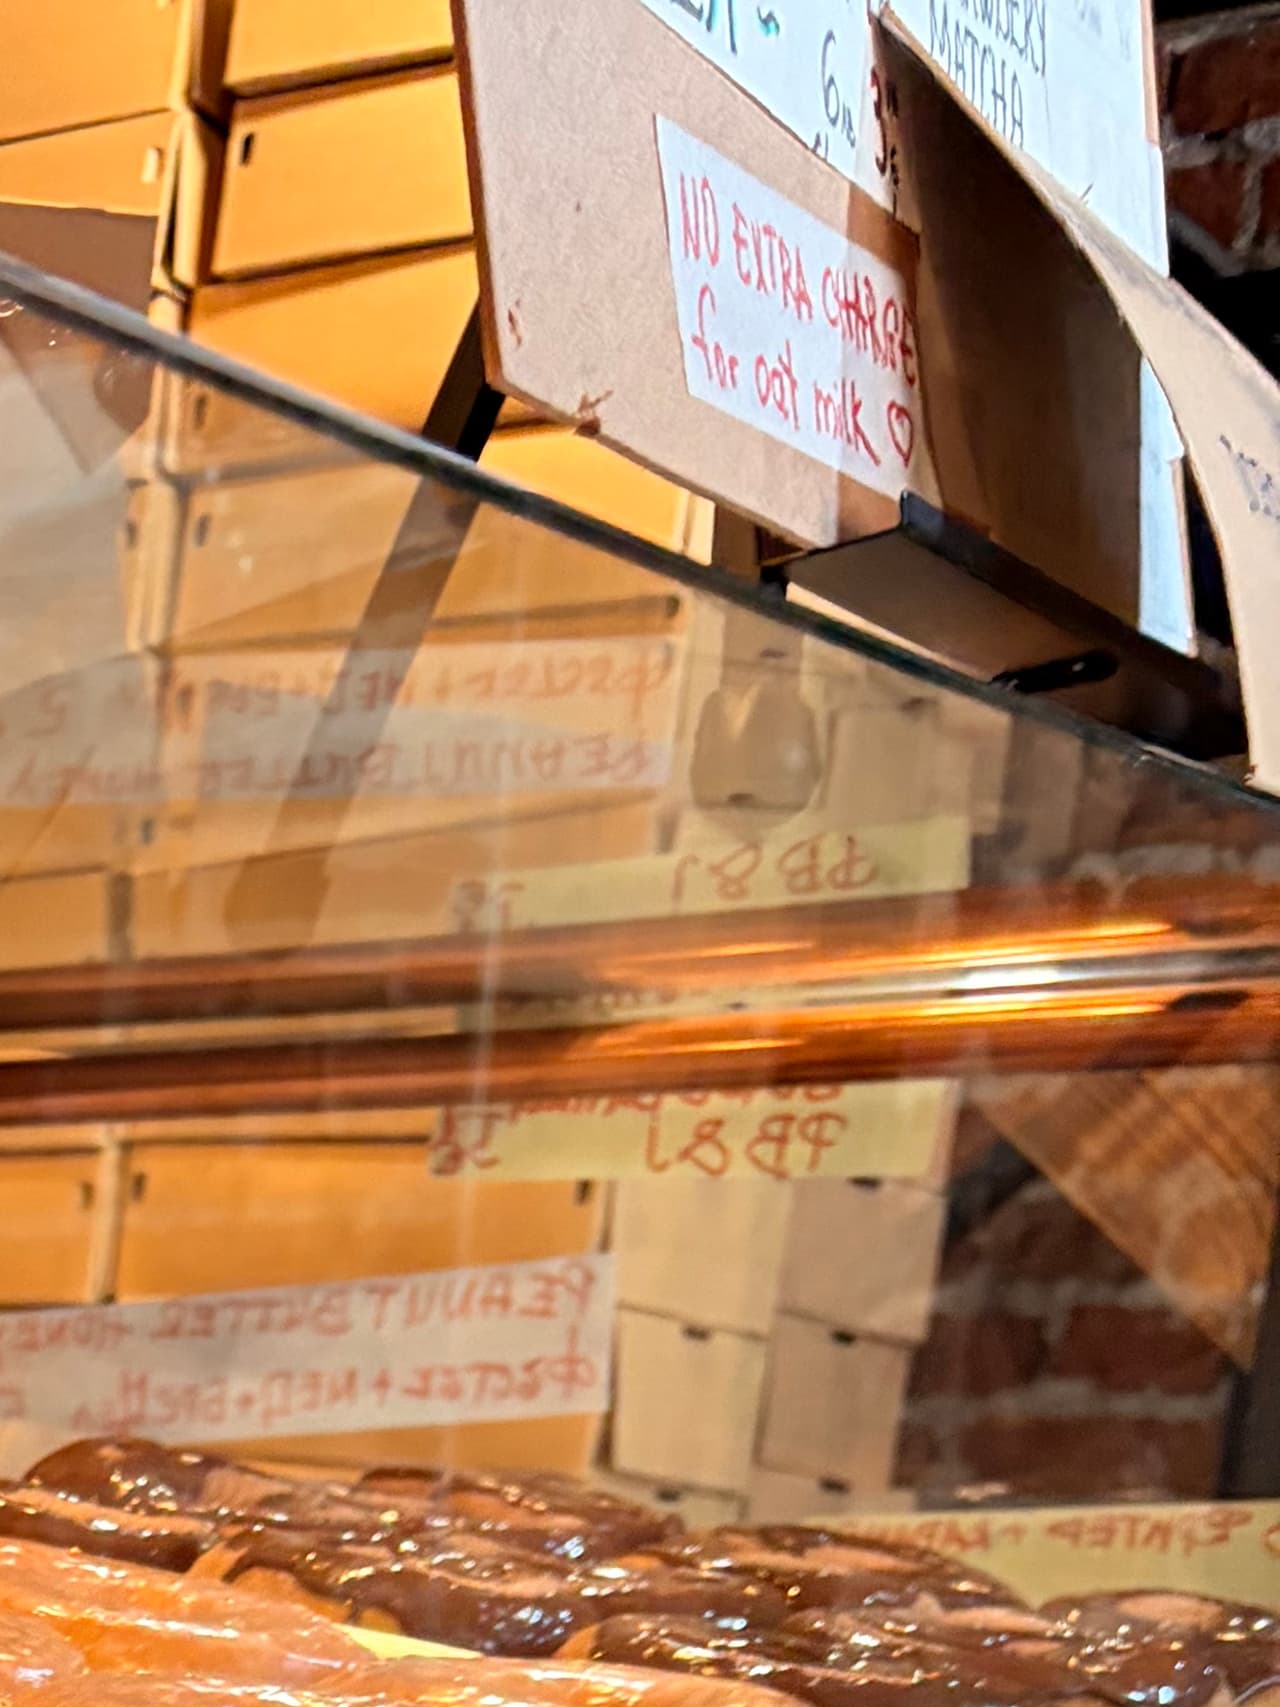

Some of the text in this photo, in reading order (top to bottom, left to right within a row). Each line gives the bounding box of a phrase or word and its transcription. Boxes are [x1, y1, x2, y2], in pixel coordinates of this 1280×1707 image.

[679, 170, 917, 388] NO EXTRA CHARGE
[691, 283, 882, 468] for oat milk
